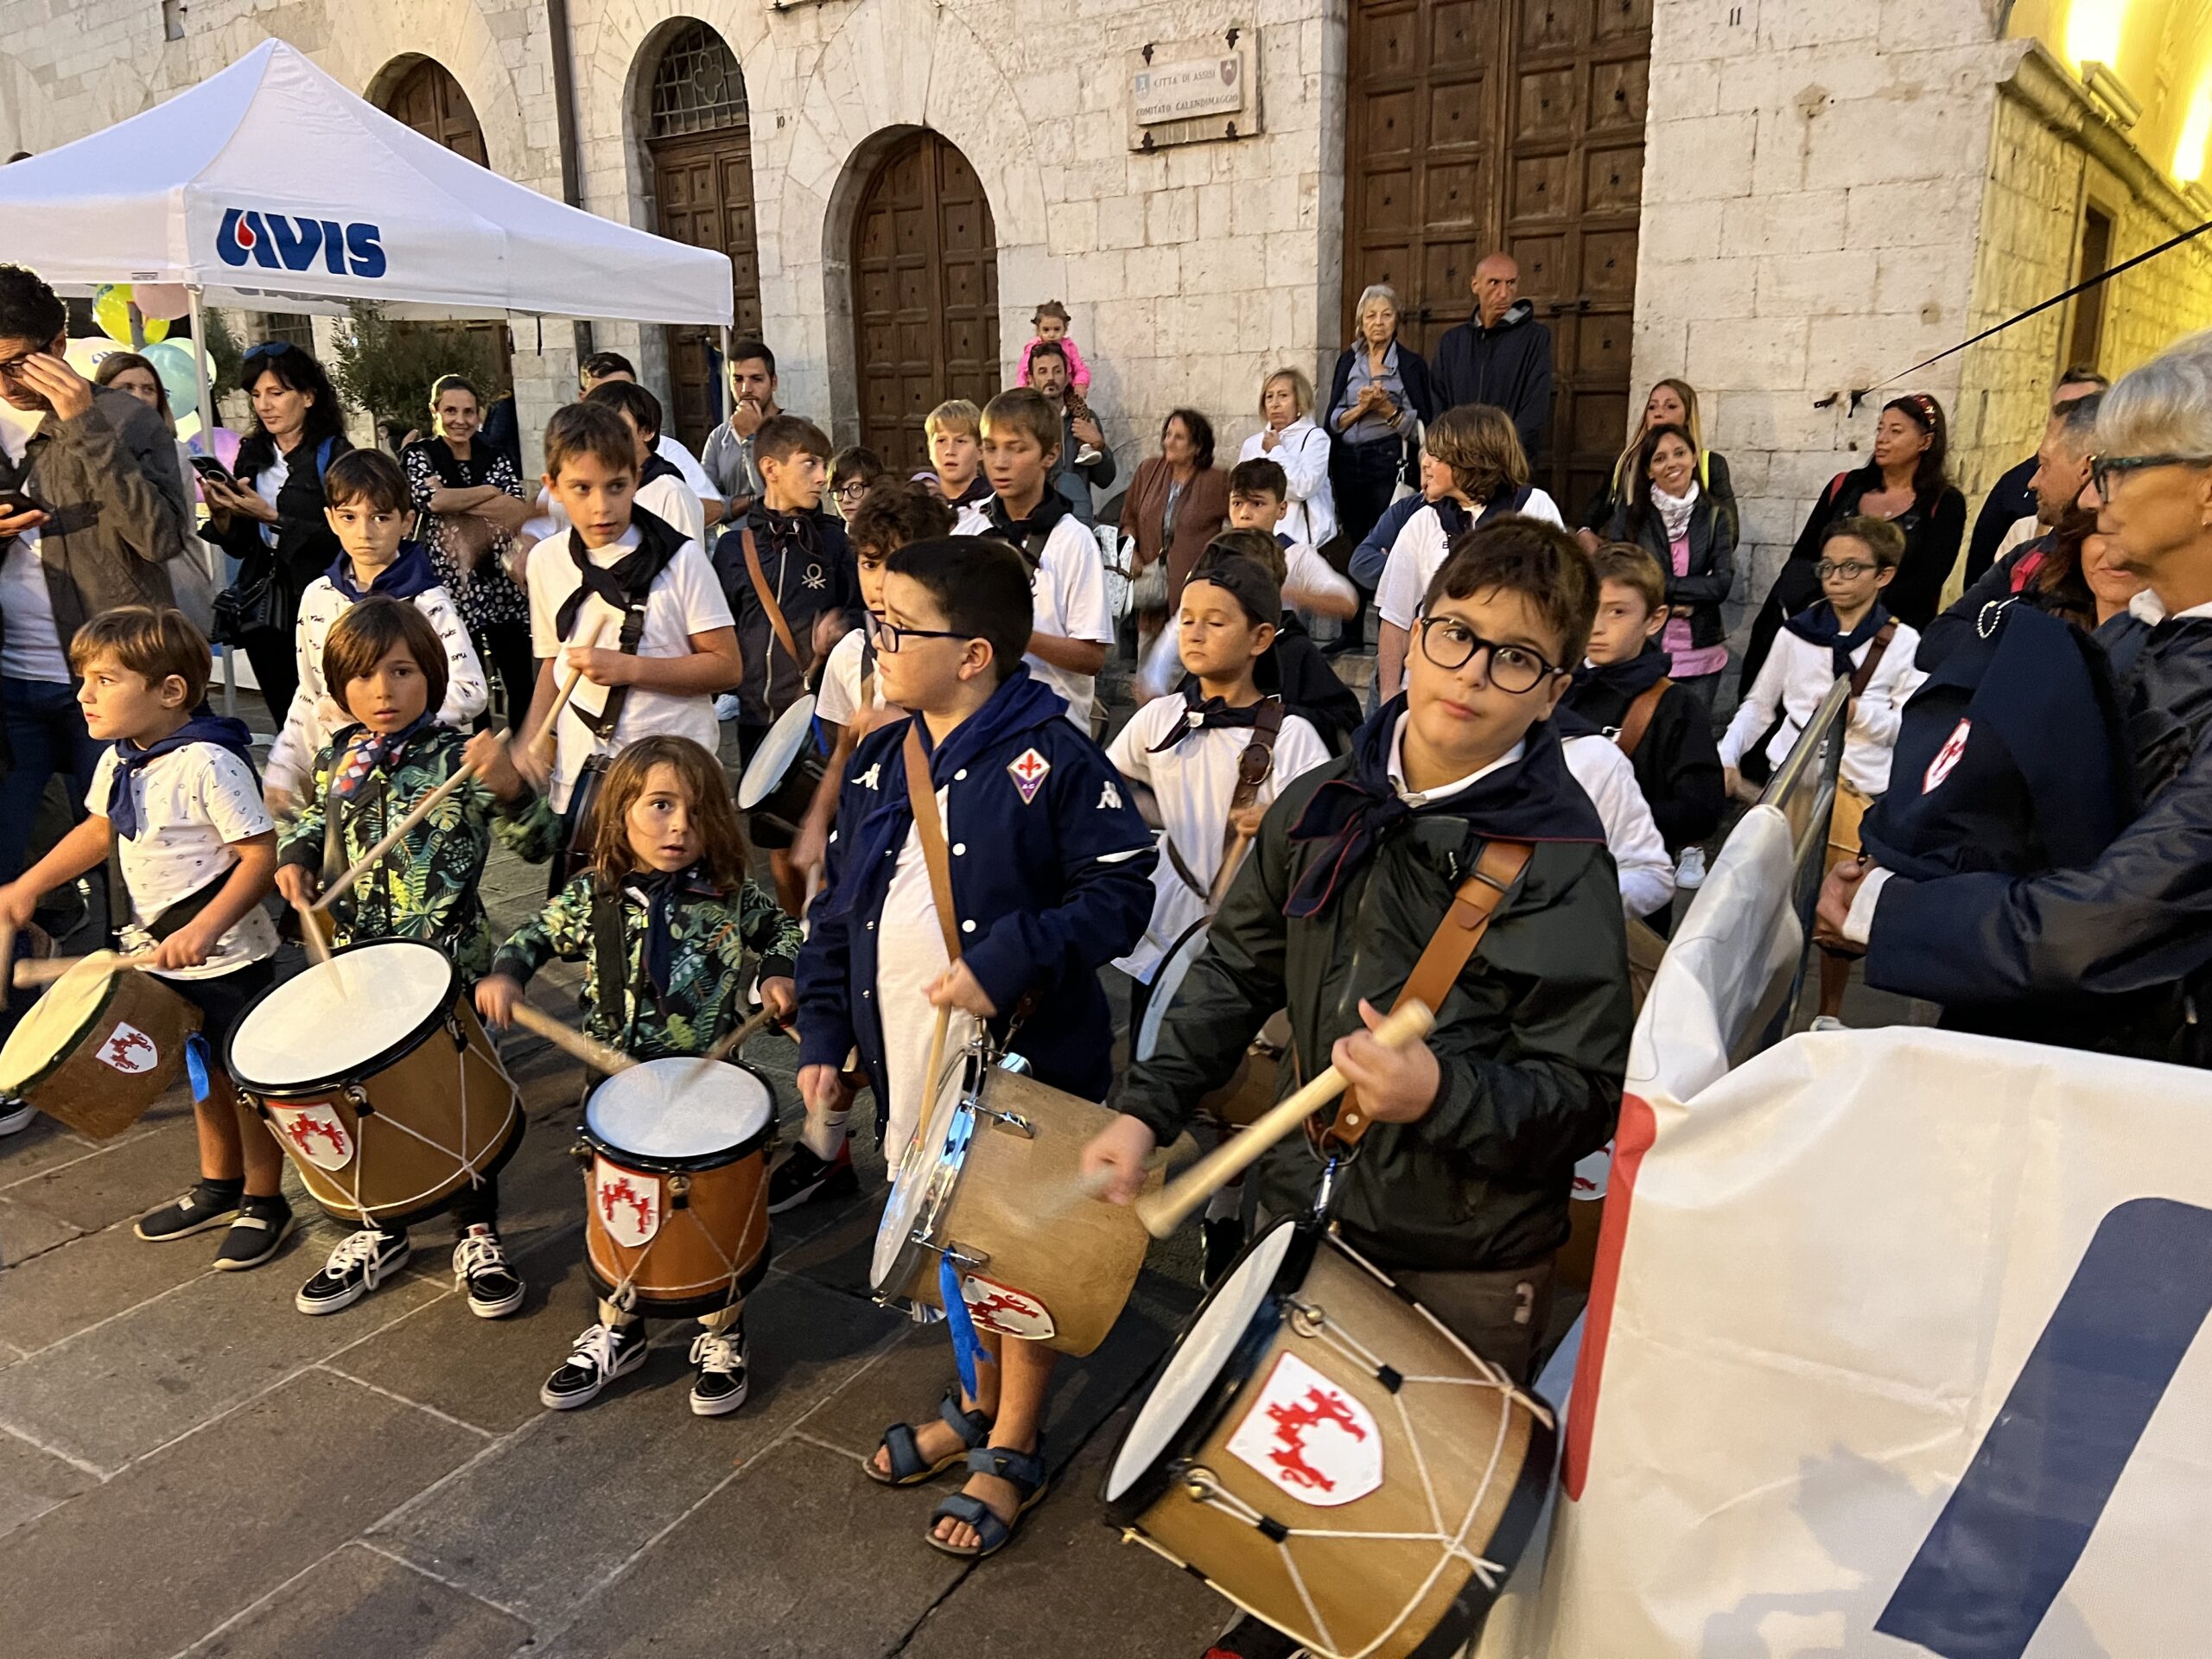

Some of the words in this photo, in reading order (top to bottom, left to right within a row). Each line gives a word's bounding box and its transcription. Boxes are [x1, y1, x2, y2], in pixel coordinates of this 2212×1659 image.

[1182, 74, 1191, 84] DI
[1193, 70, 1216, 82] ASSISI
[1136, 105, 1172, 117] COMITATO
[1176, 95, 1238, 111] CALENDIMAGGIO
[777, 116, 785, 129] 10
[216, 207, 386, 278] AVIS
